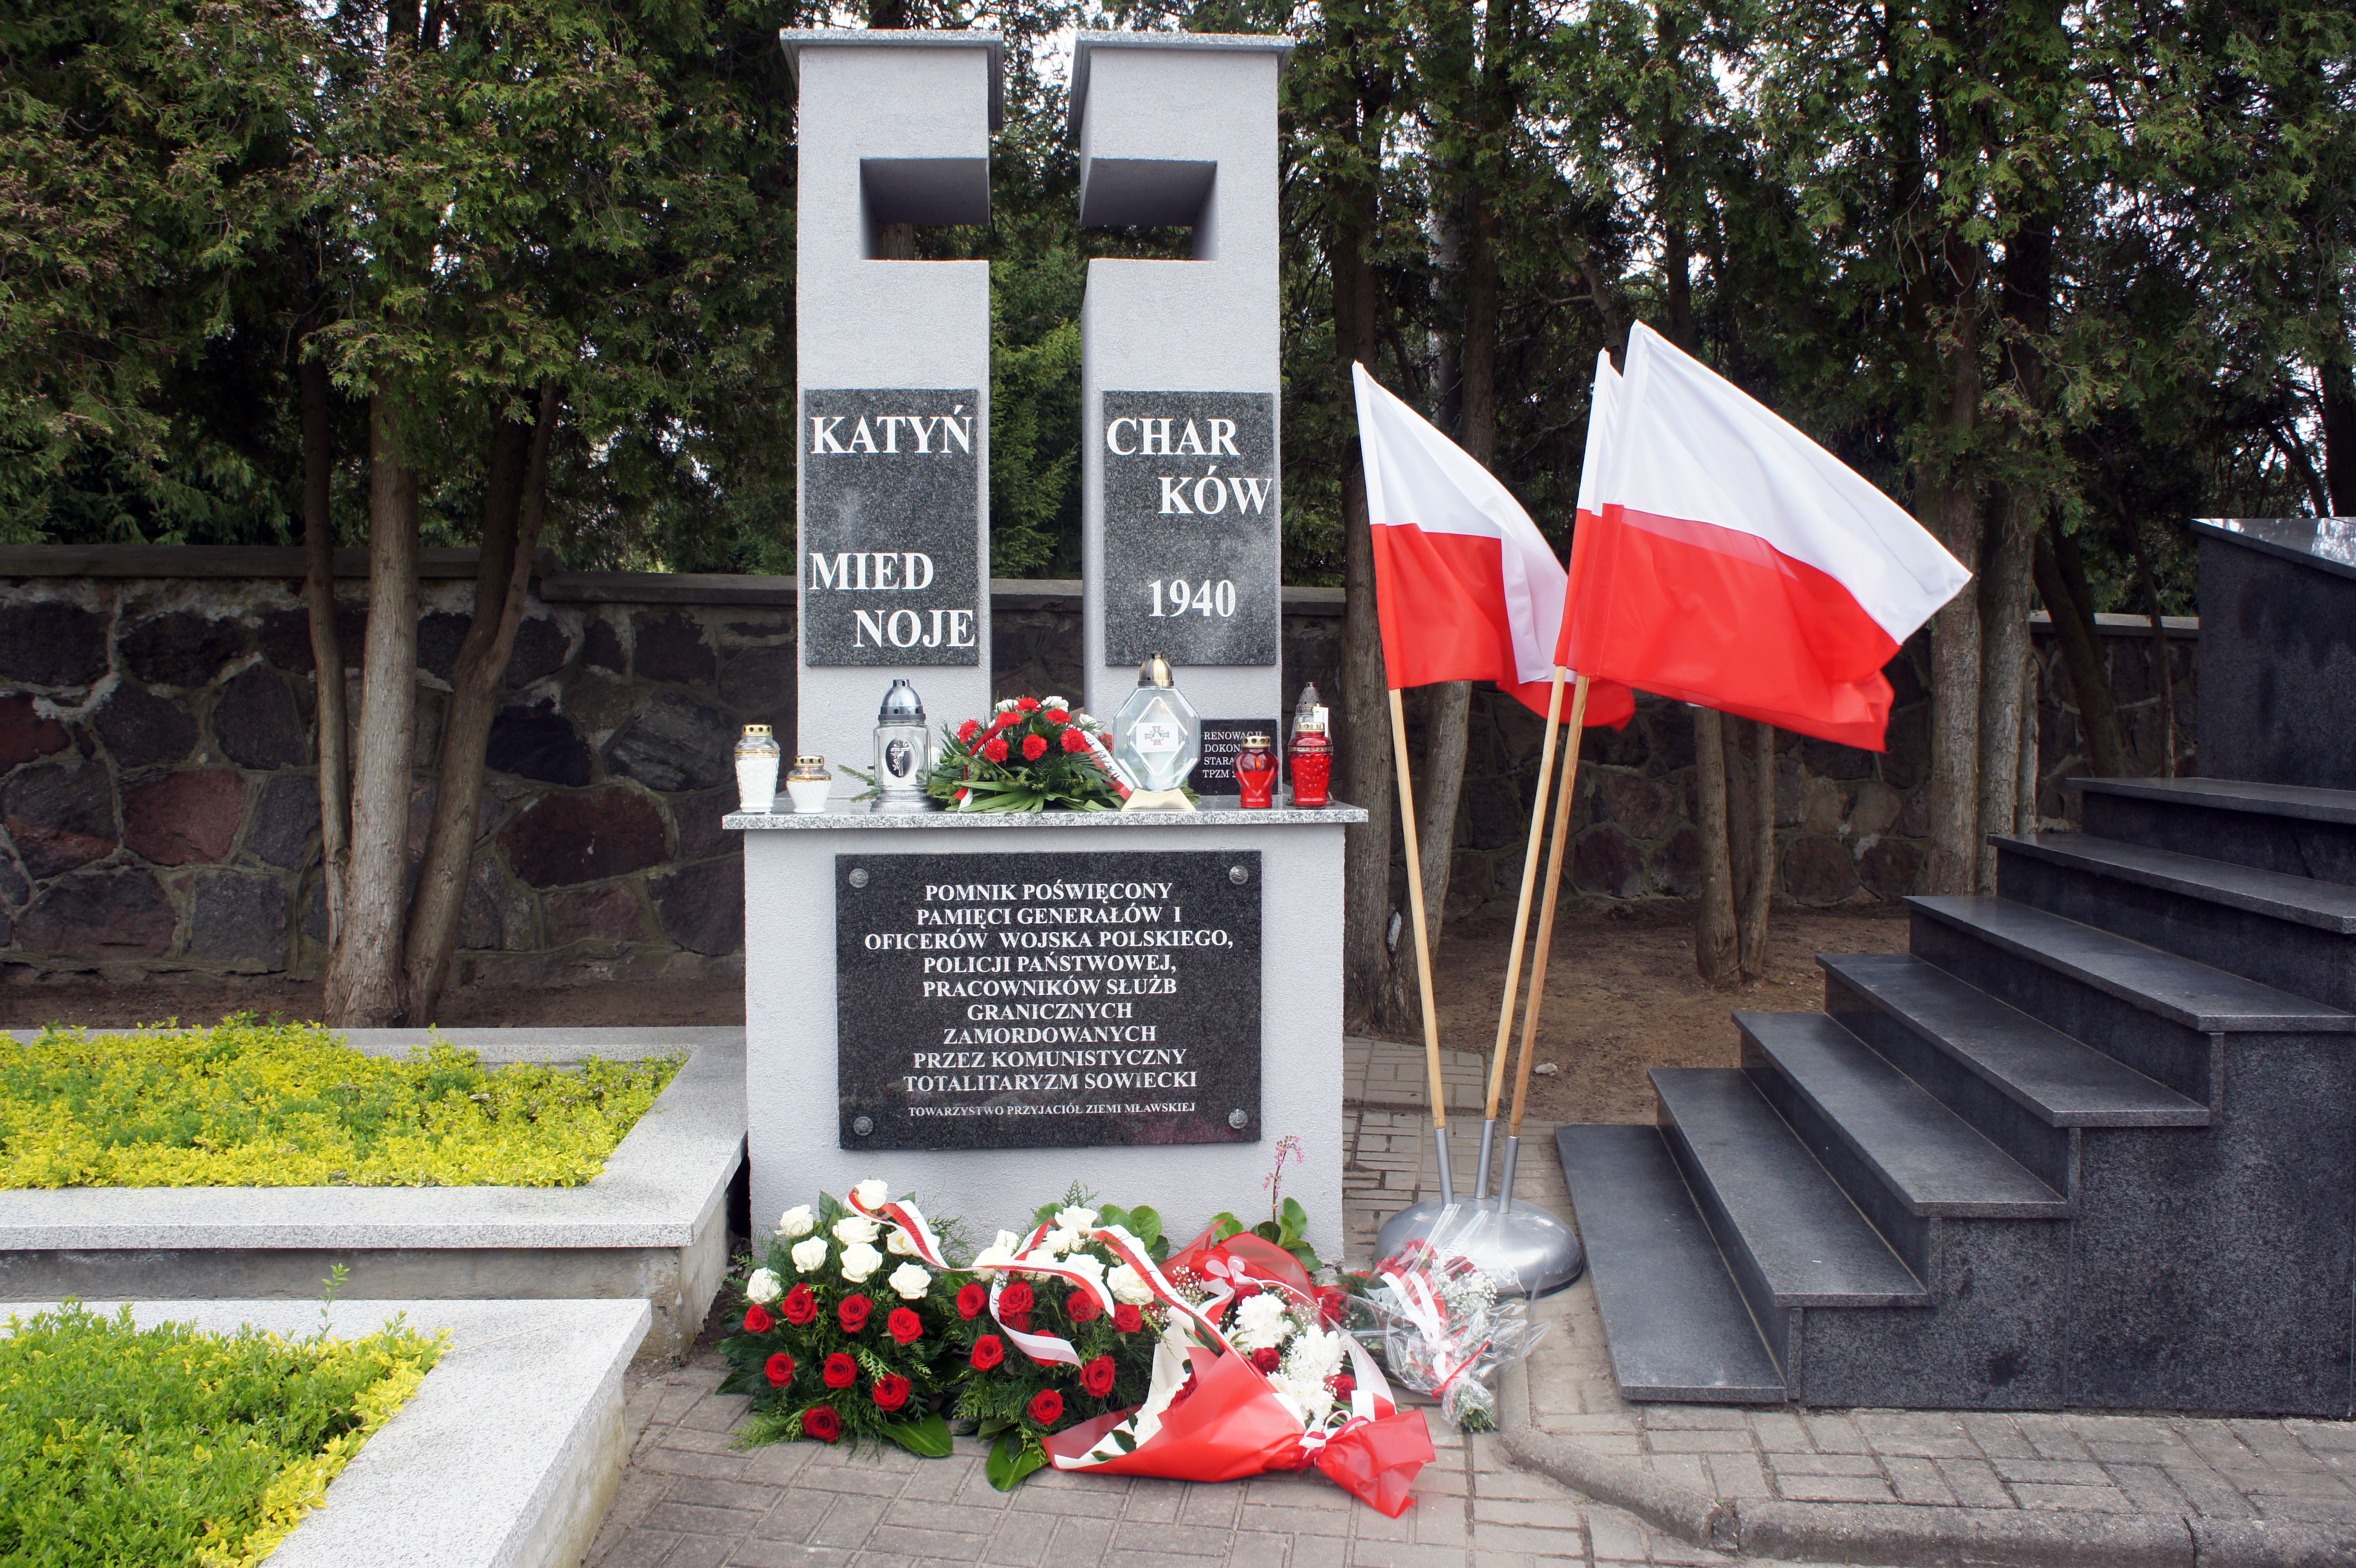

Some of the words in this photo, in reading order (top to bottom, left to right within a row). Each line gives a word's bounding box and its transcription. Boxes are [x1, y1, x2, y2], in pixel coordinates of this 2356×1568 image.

[811, 405, 972, 454] KATYŃ
[1107, 418, 1240, 455] CHAR
[1158, 465, 1272, 514] KÓW
[809, 553, 933, 590] MIED
[1148, 579, 1235, 617] 1940
[853, 610, 974, 647] NOJE
[1204, 744, 1242, 753] DOKON
[1204, 757, 1234, 765] STARA
[1203, 770, 1229, 778] TPZM
[925, 884, 1017, 901] POMNIK
[1022, 879, 1173, 904] POŚWIĘCONY
[916, 908, 1011, 929] PAMIĘCI
[1017, 902, 1163, 925] GENERAŁÓW
[1173, 906, 1181, 923] I
[865, 928, 988, 950] OFICERÓW
[998, 931, 1093, 948] WOJSKA
[1098, 929, 1233, 949] POLSKIEGO,
[924, 956, 1011, 973] POLICJI
[1017, 951, 1176, 974] PAŃSTWOWEJ,
[922, 974, 1101, 997] PRACOWNIKÓW
[1106, 974, 1177, 995] SŁUŻB
[967, 1002, 1133, 1021] GRANICZNYCH
[943, 1025, 1157, 1045] ZAMORDOWANYCH
[913, 1052, 986, 1069] PRZEZ
[991, 1048, 1187, 1068] KOMUNISTYCZNY
[903, 1073, 1078, 1092] TOTALITARYZM
[1085, 1071, 1197, 1089] SOWIECKI
[908, 1106, 1004, 1116] TOWARZYSTWO
[1007, 1102, 1083, 1115] PRZYJACIÓŁ
[1086, 1104, 1121, 1113] ZIEMI
[1124, 1102, 1195, 1113] MŁAWSKIEJ
